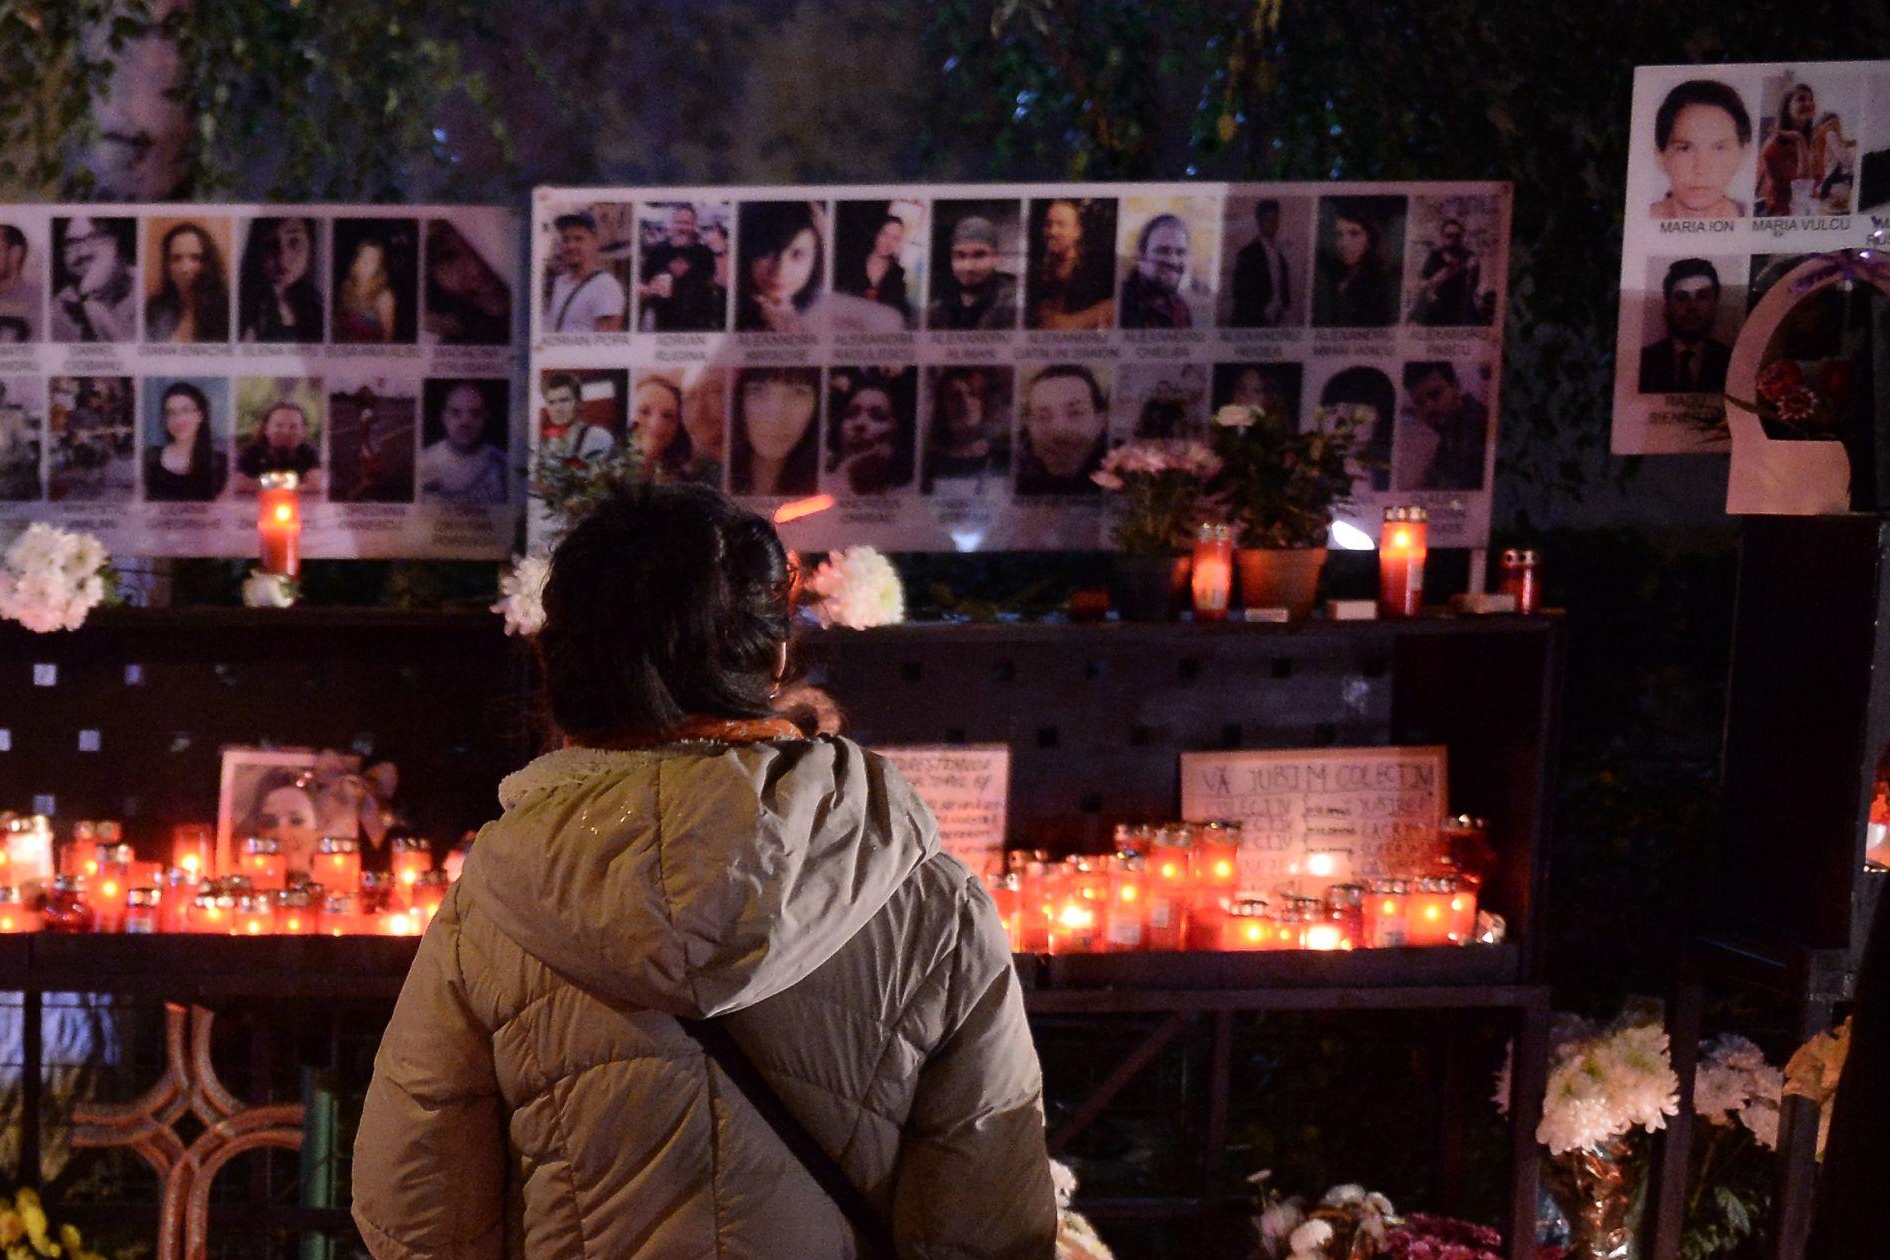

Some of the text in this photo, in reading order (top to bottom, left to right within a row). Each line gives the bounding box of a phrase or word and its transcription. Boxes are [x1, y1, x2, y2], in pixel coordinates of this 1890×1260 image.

[1659, 220, 1735, 233] MARIA ION
[1751, 218, 1851, 231] MARIA VULCU
